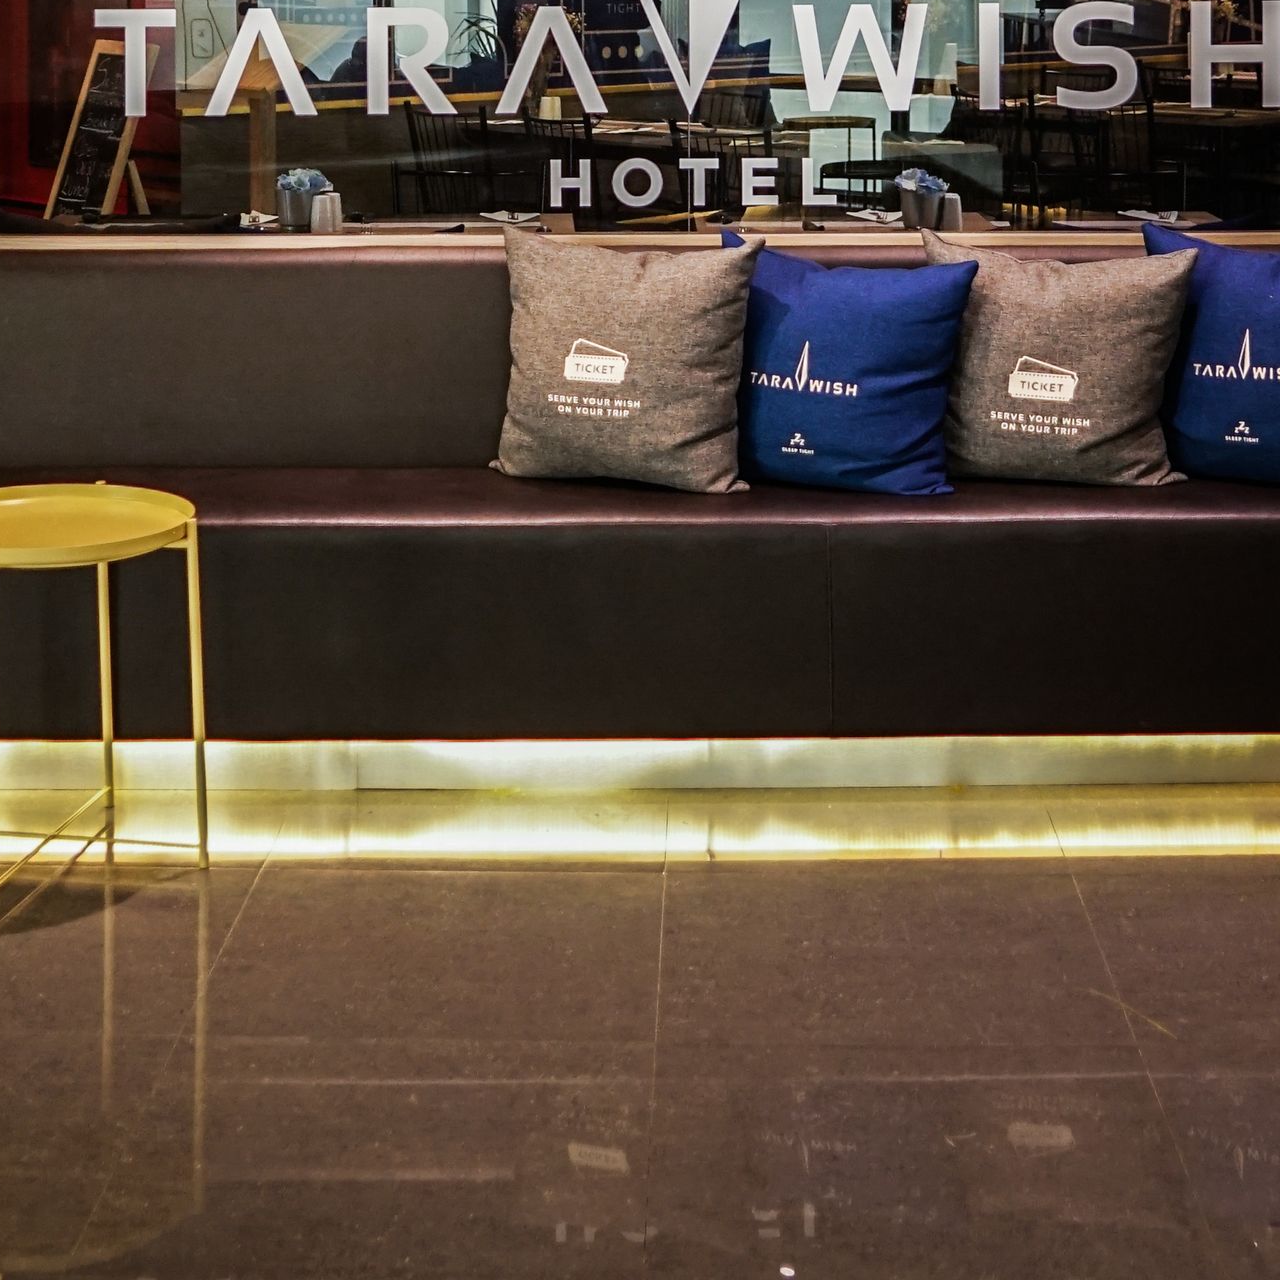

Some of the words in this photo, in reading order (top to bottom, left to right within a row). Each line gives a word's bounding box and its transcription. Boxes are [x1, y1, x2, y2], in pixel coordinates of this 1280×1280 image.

[606, 2, 641, 15] TIGHT
[93, 6, 609, 117] TARA
[548, 157, 837, 209] HOTEL
[575, 362, 615, 375] TICKET
[1192, 363, 1238, 379] TARA
[750, 371, 794, 391] TARA
[809, 379, 859, 397] WISH
[1019, 380, 1064, 393] TICKET
[547, 393, 579, 404] SERVE
[582, 397, 611, 407] YOUR
[614, 399, 641, 409] WISH
[557, 404, 572, 413] ON
[575, 406, 603, 416] YOUR
[607, 408, 630, 418] TRIP
[990, 410, 1025, 421] SERVE
[1028, 414, 1058, 424] YOUR
[1062, 417, 1091, 427] WISH
[1000, 422, 1017, 431] ON
[1020, 423, 1051, 434] YOUR
[1053, 426, 1079, 436] TRIP
[1224, 435, 1243, 443] SLEEP
[1243, 436, 1260, 444] TIGHT
[799, 447, 815, 455] TIGHT
